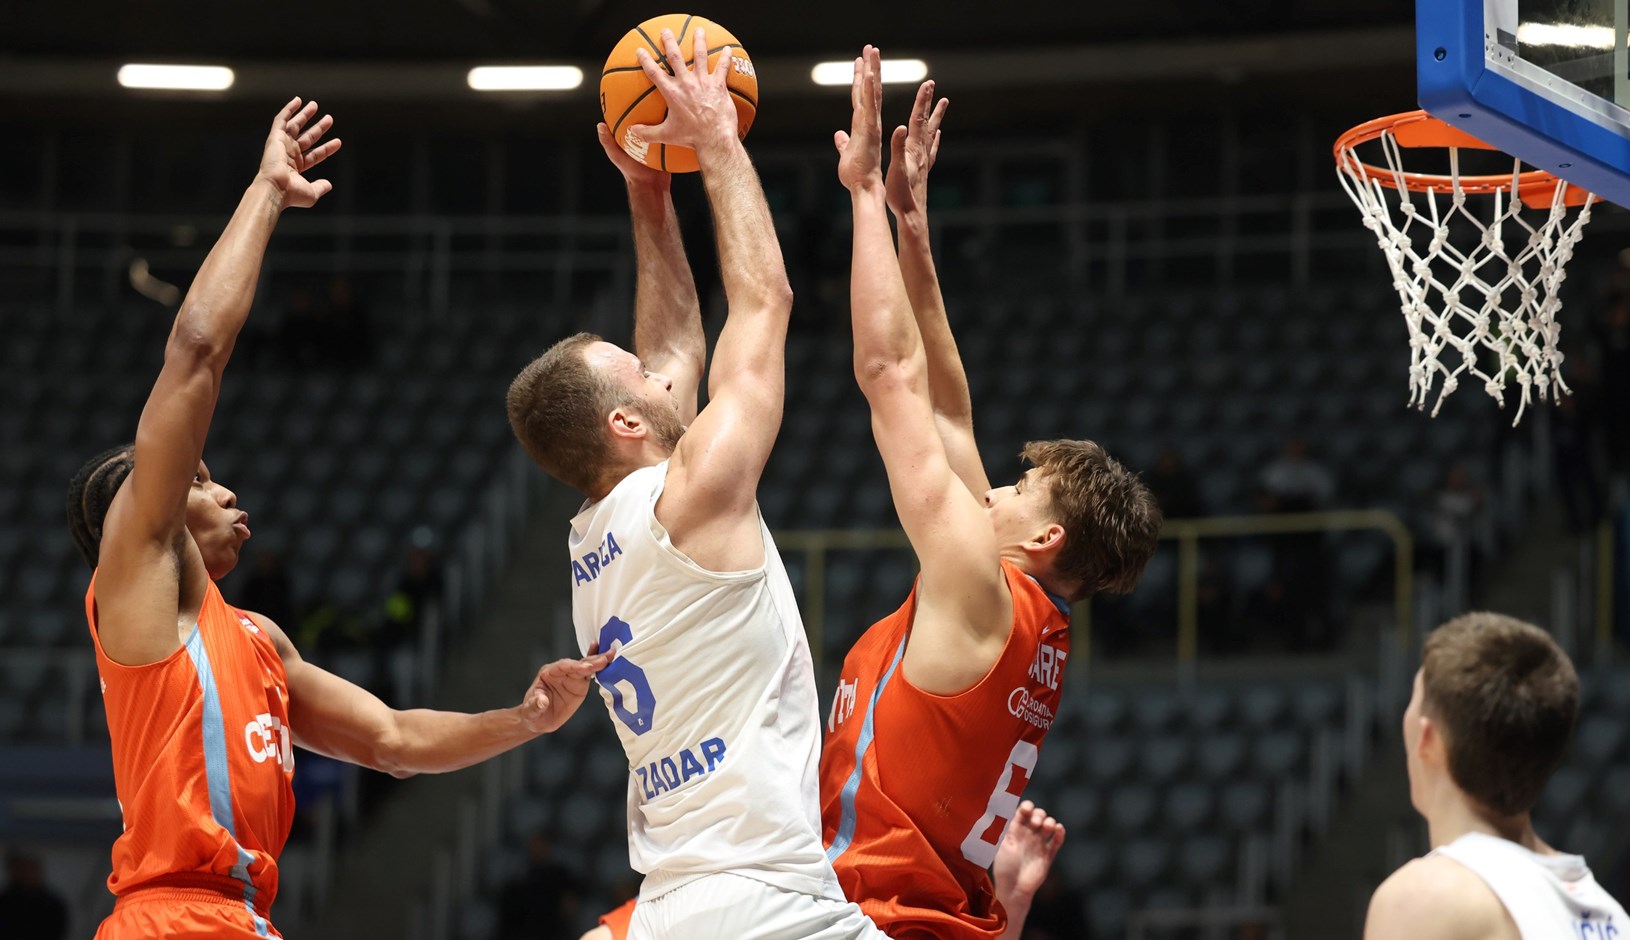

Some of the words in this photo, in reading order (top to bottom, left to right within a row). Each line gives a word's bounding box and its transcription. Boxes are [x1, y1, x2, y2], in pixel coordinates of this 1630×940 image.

[595, 615, 656, 736] 6
[1028, 641, 1067, 691] ARE
[1024, 710, 1054, 731] OSIGUR
[1026, 697, 1054, 718] ROATIA
[636, 737, 727, 800] ZADAR
[960, 739, 1038, 869] 6
